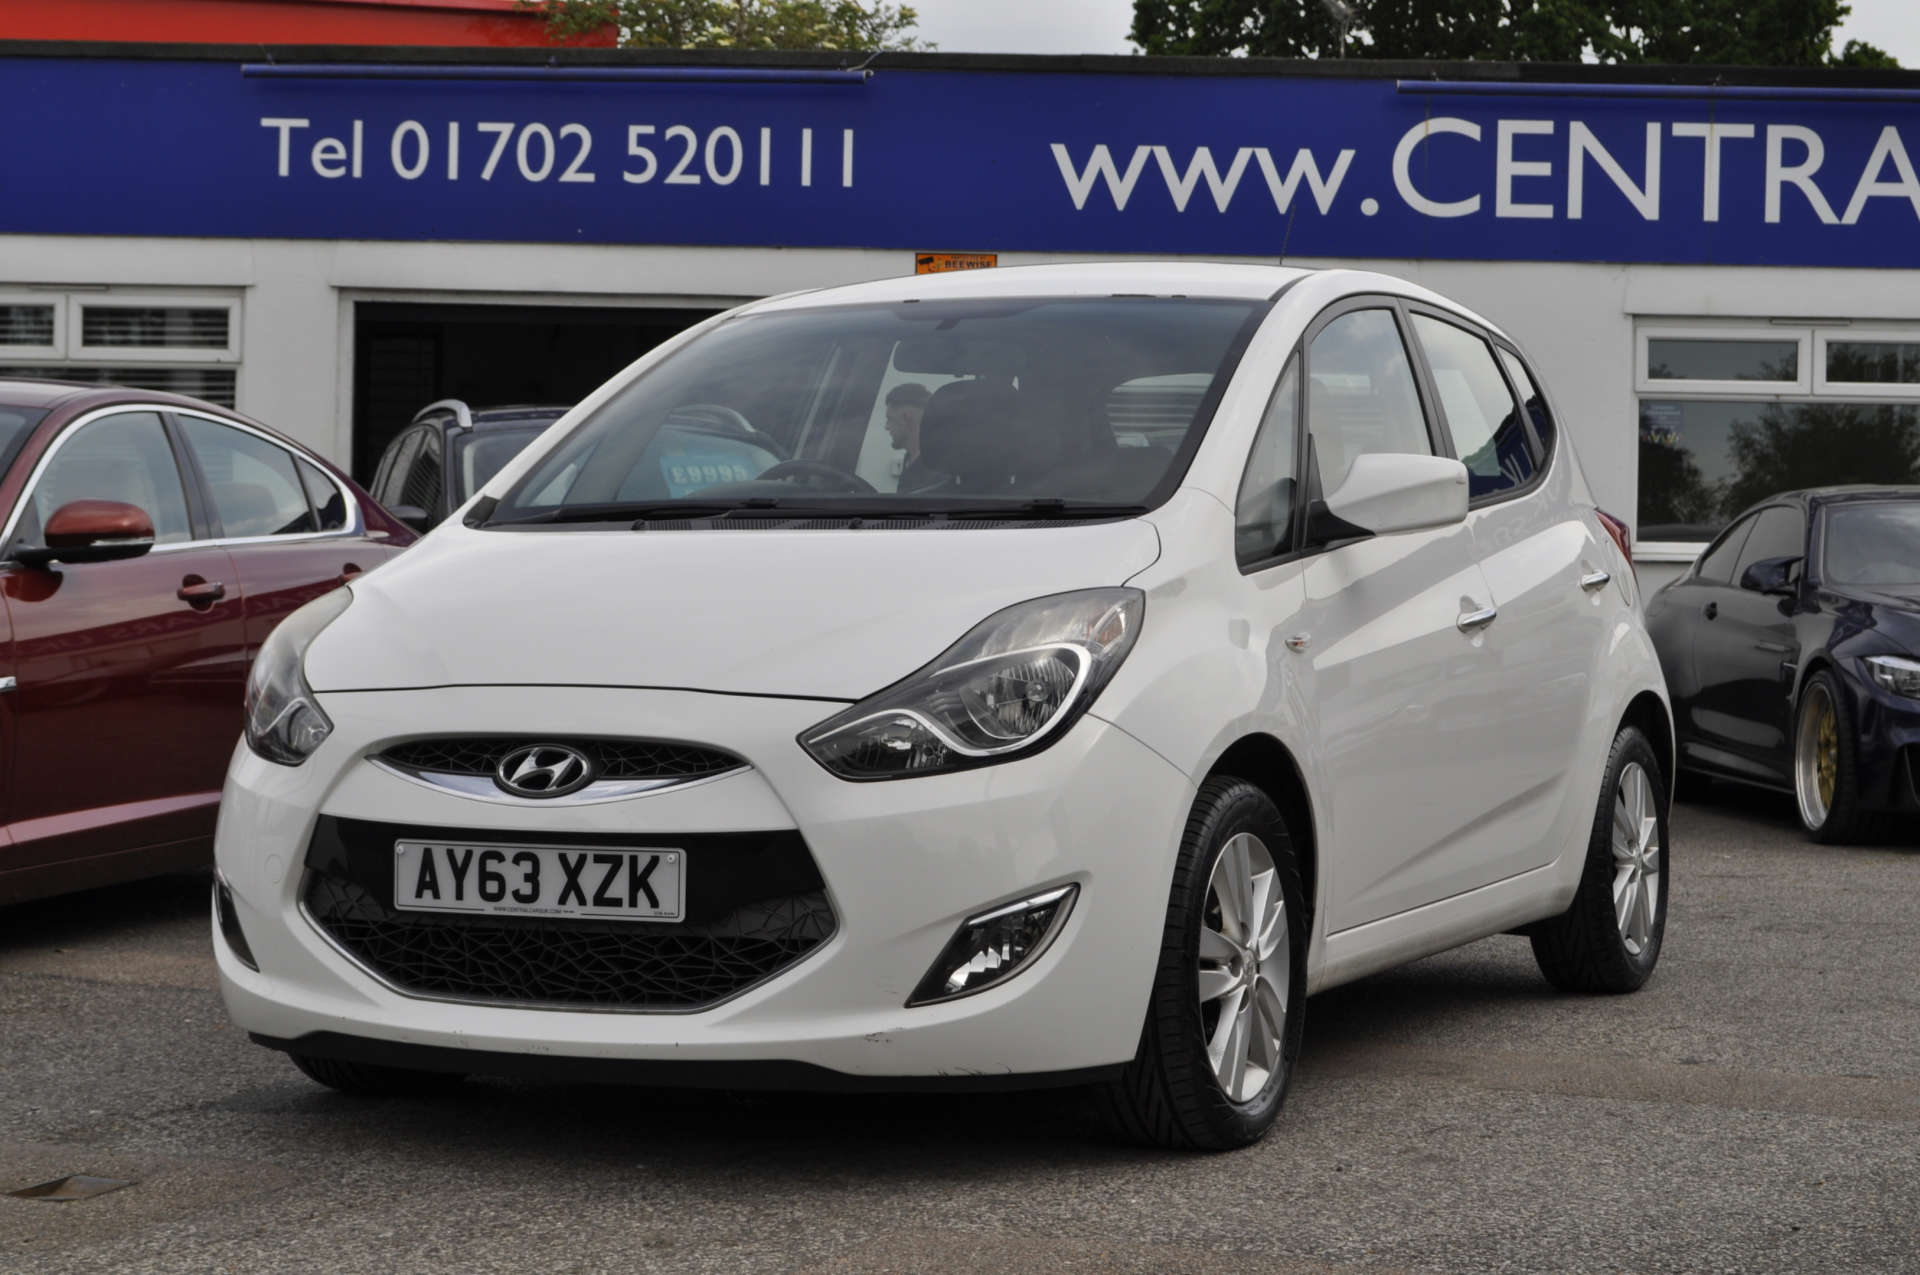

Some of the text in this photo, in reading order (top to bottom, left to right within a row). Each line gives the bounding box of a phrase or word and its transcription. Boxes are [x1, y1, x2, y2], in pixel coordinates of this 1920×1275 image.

[261, 118, 854, 187] Tel 01702 520111
[415, 848, 660, 909] AY63 XZK
